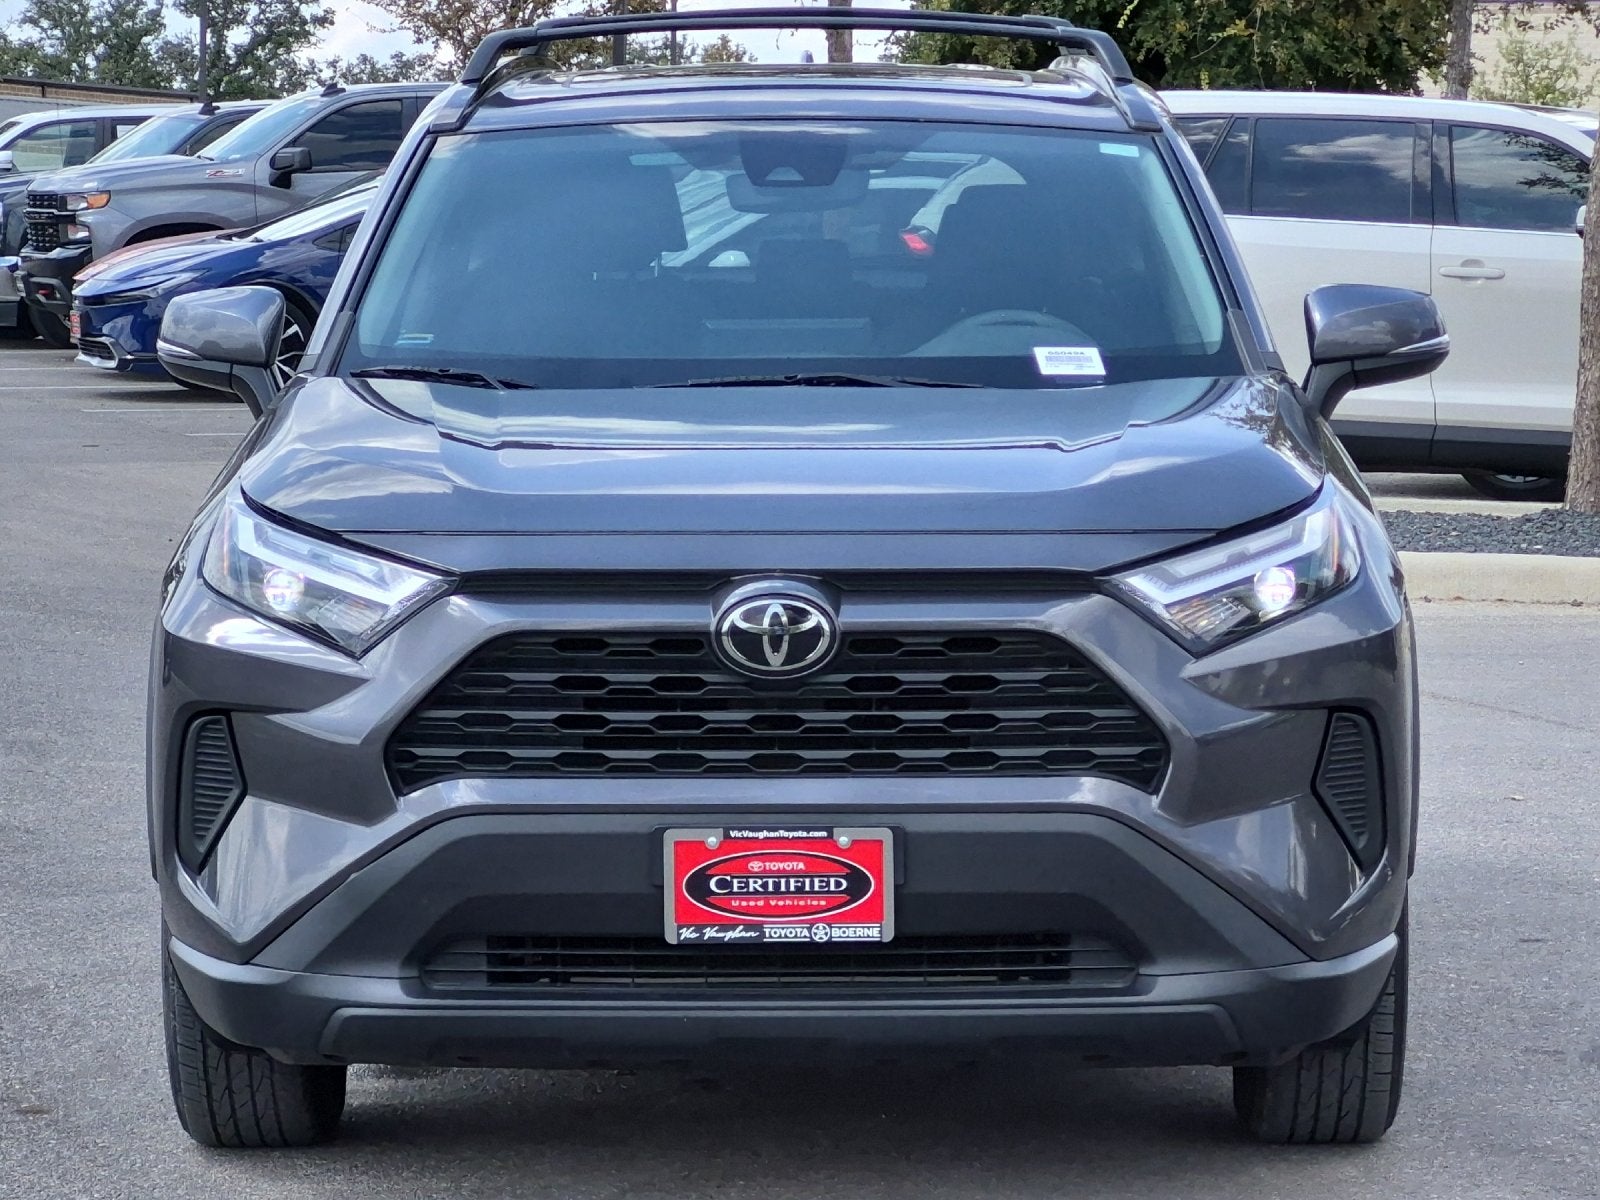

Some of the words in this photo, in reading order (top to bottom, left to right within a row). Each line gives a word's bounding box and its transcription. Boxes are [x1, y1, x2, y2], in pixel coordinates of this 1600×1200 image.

[729, 830, 828, 839] VicVaughanToyota.com
[763, 861, 806, 870] TOYOTA
[709, 875, 848, 893] CERTIFIED
[679, 926, 700, 940] Vic
[702, 925, 760, 941] Vaughan
[763, 928, 811, 938] TOYOTA
[832, 928, 881, 937] BOERNE
